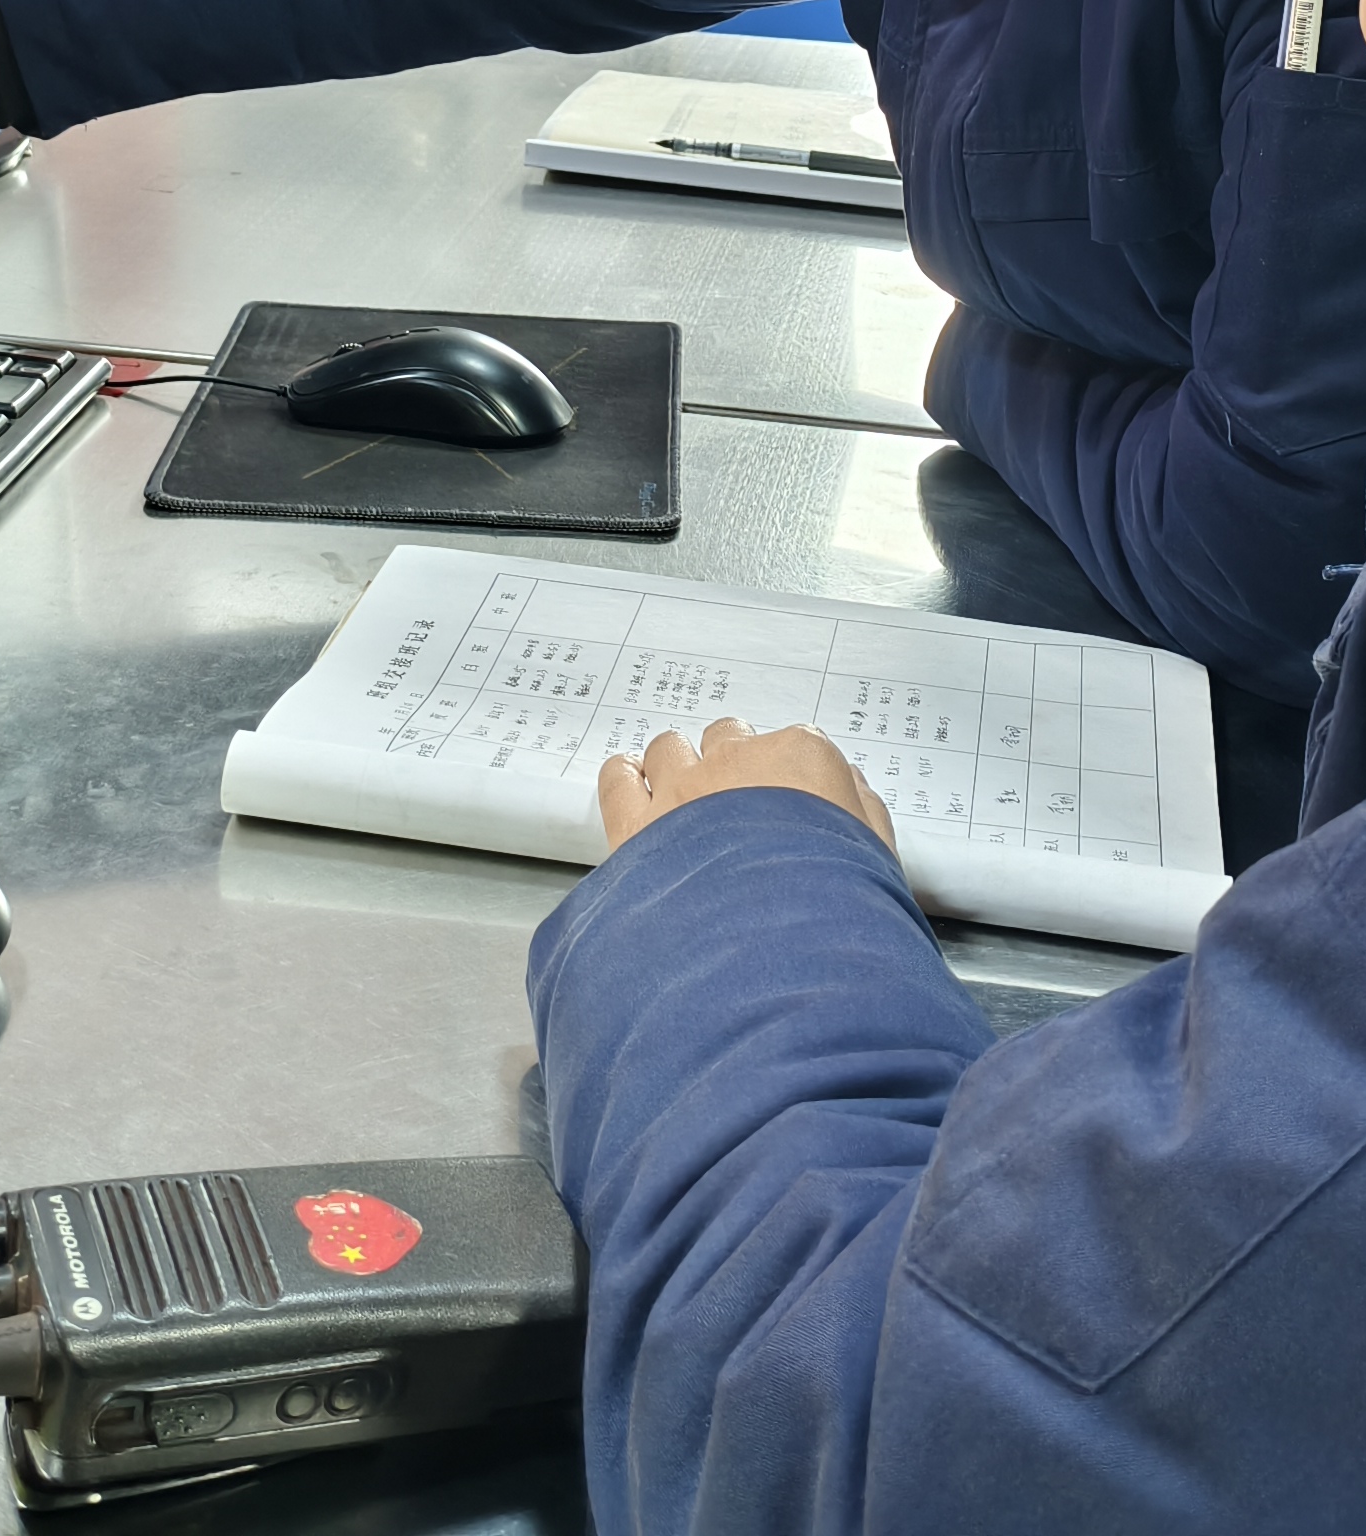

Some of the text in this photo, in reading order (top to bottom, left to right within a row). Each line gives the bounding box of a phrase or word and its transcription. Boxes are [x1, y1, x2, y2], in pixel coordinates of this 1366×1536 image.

[366, 619, 436, 700] 班组交接班记录
[48, 1194, 90, 1289] MOTOROLA
